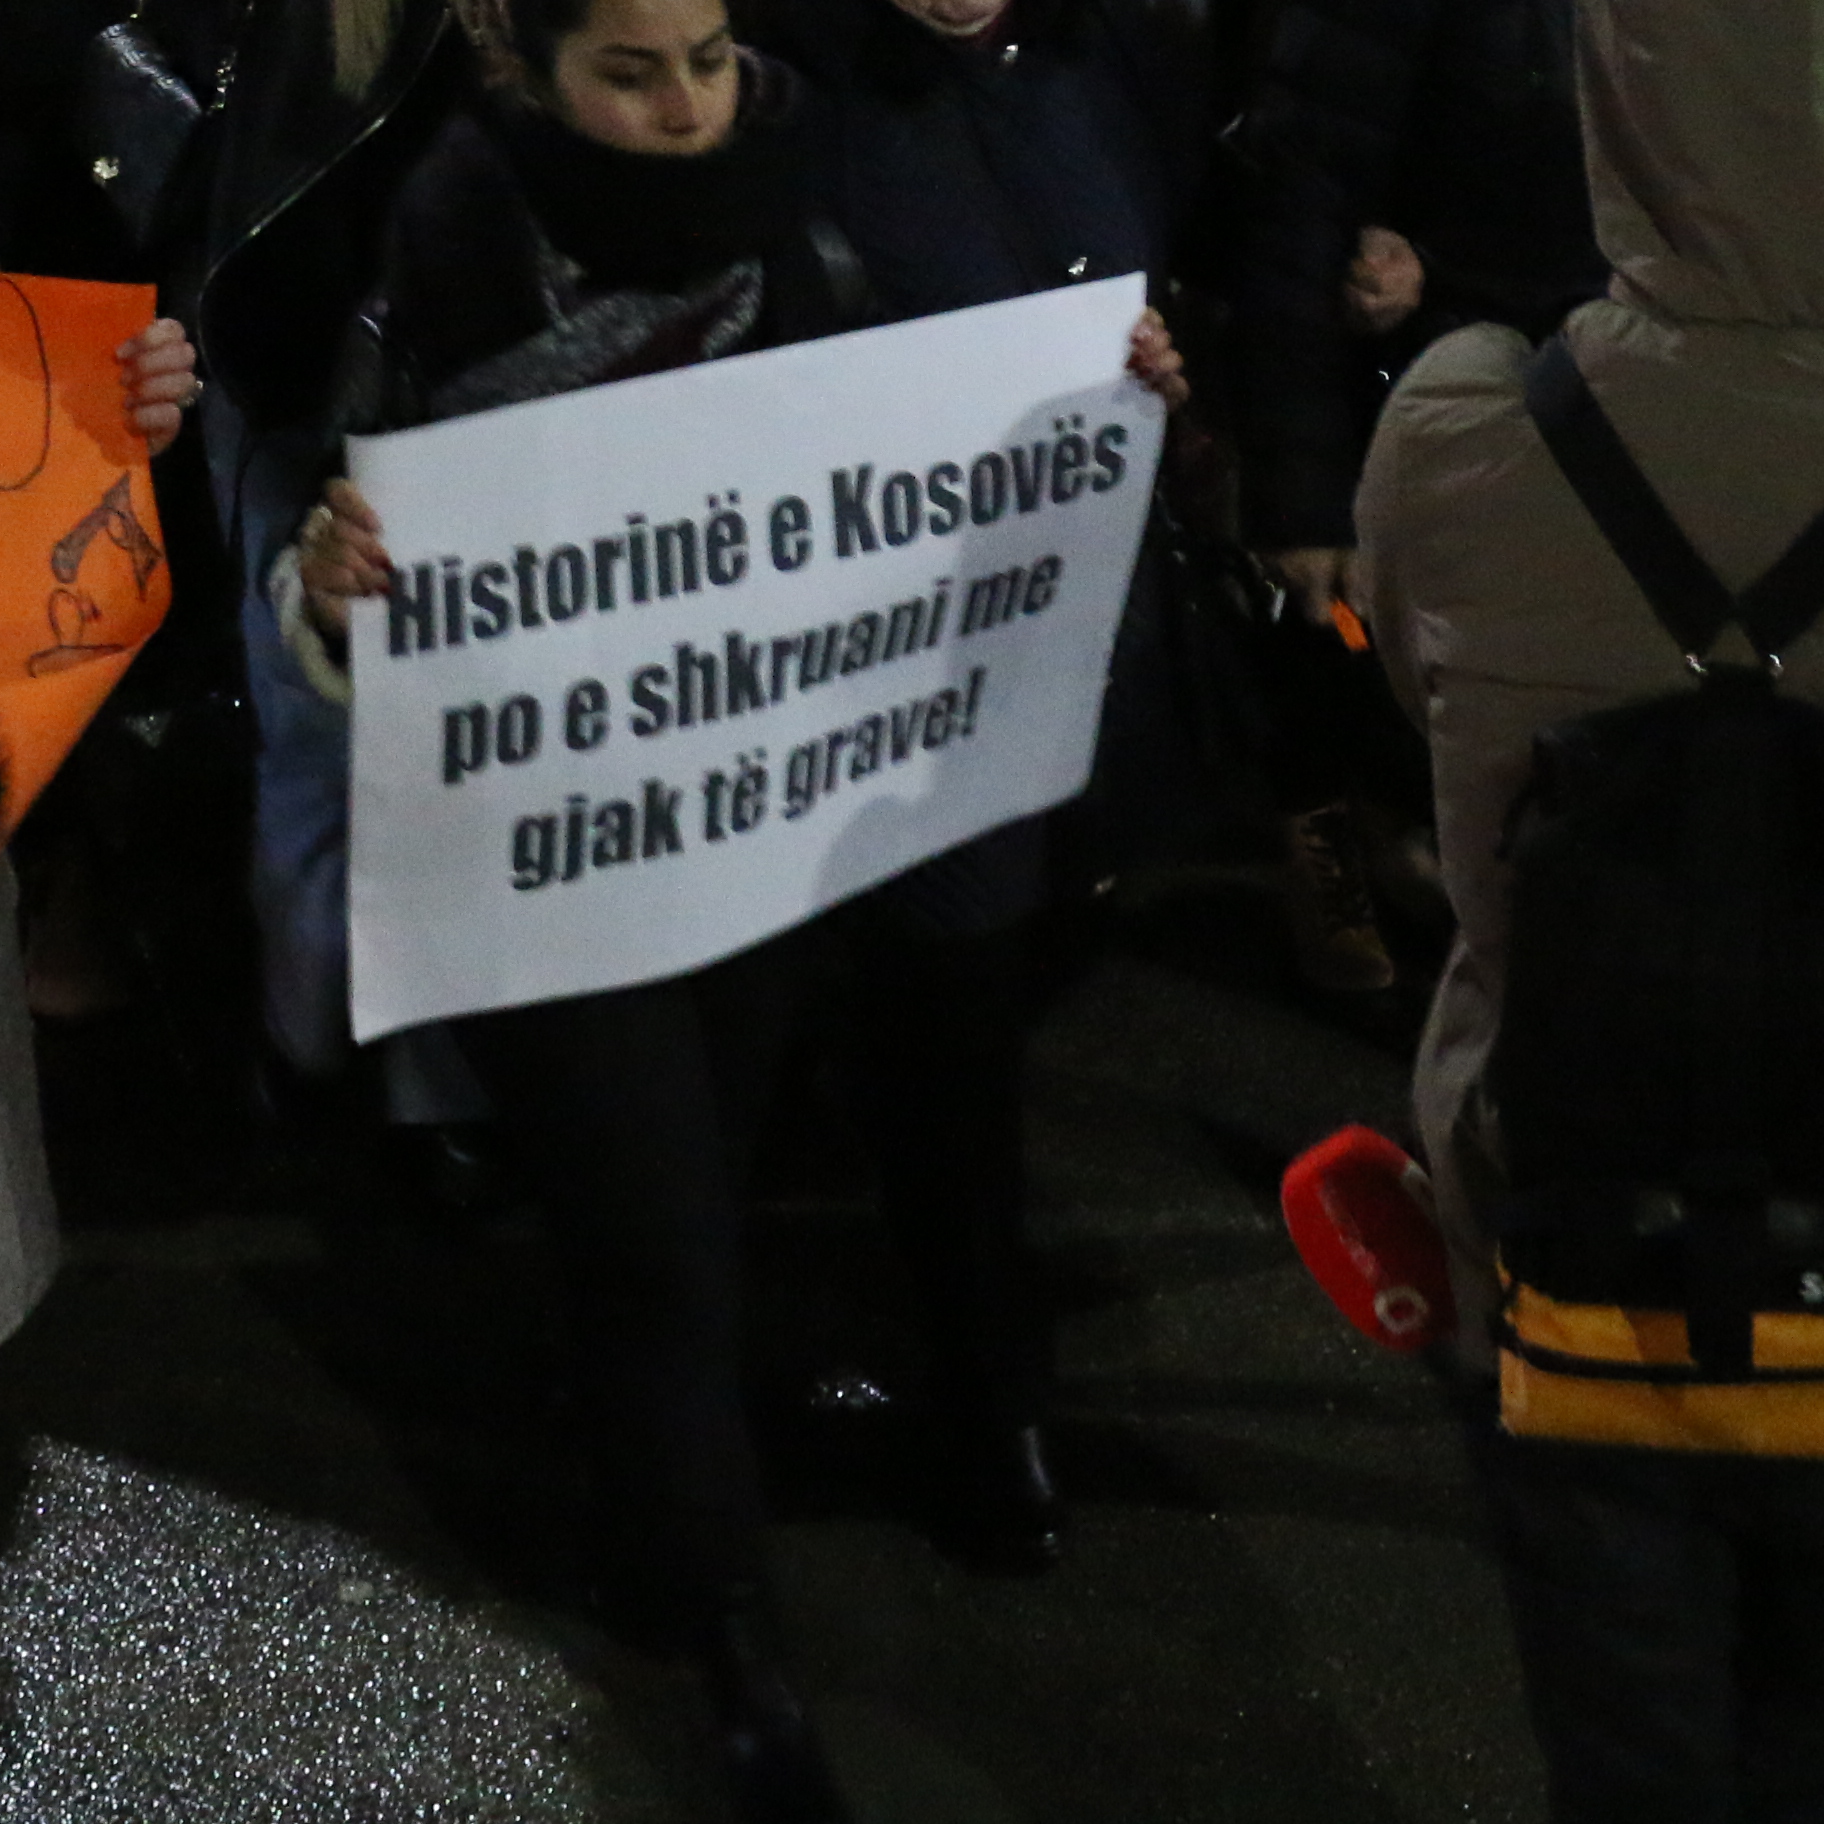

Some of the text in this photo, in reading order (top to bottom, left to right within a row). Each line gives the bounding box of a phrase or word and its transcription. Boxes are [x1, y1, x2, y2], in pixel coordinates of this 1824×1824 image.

[386, 414, 1130, 658] Historinë e Kosovës
[441, 552, 1065, 786] po e shkruani me
[509, 665, 988, 892] gjak të grave!
